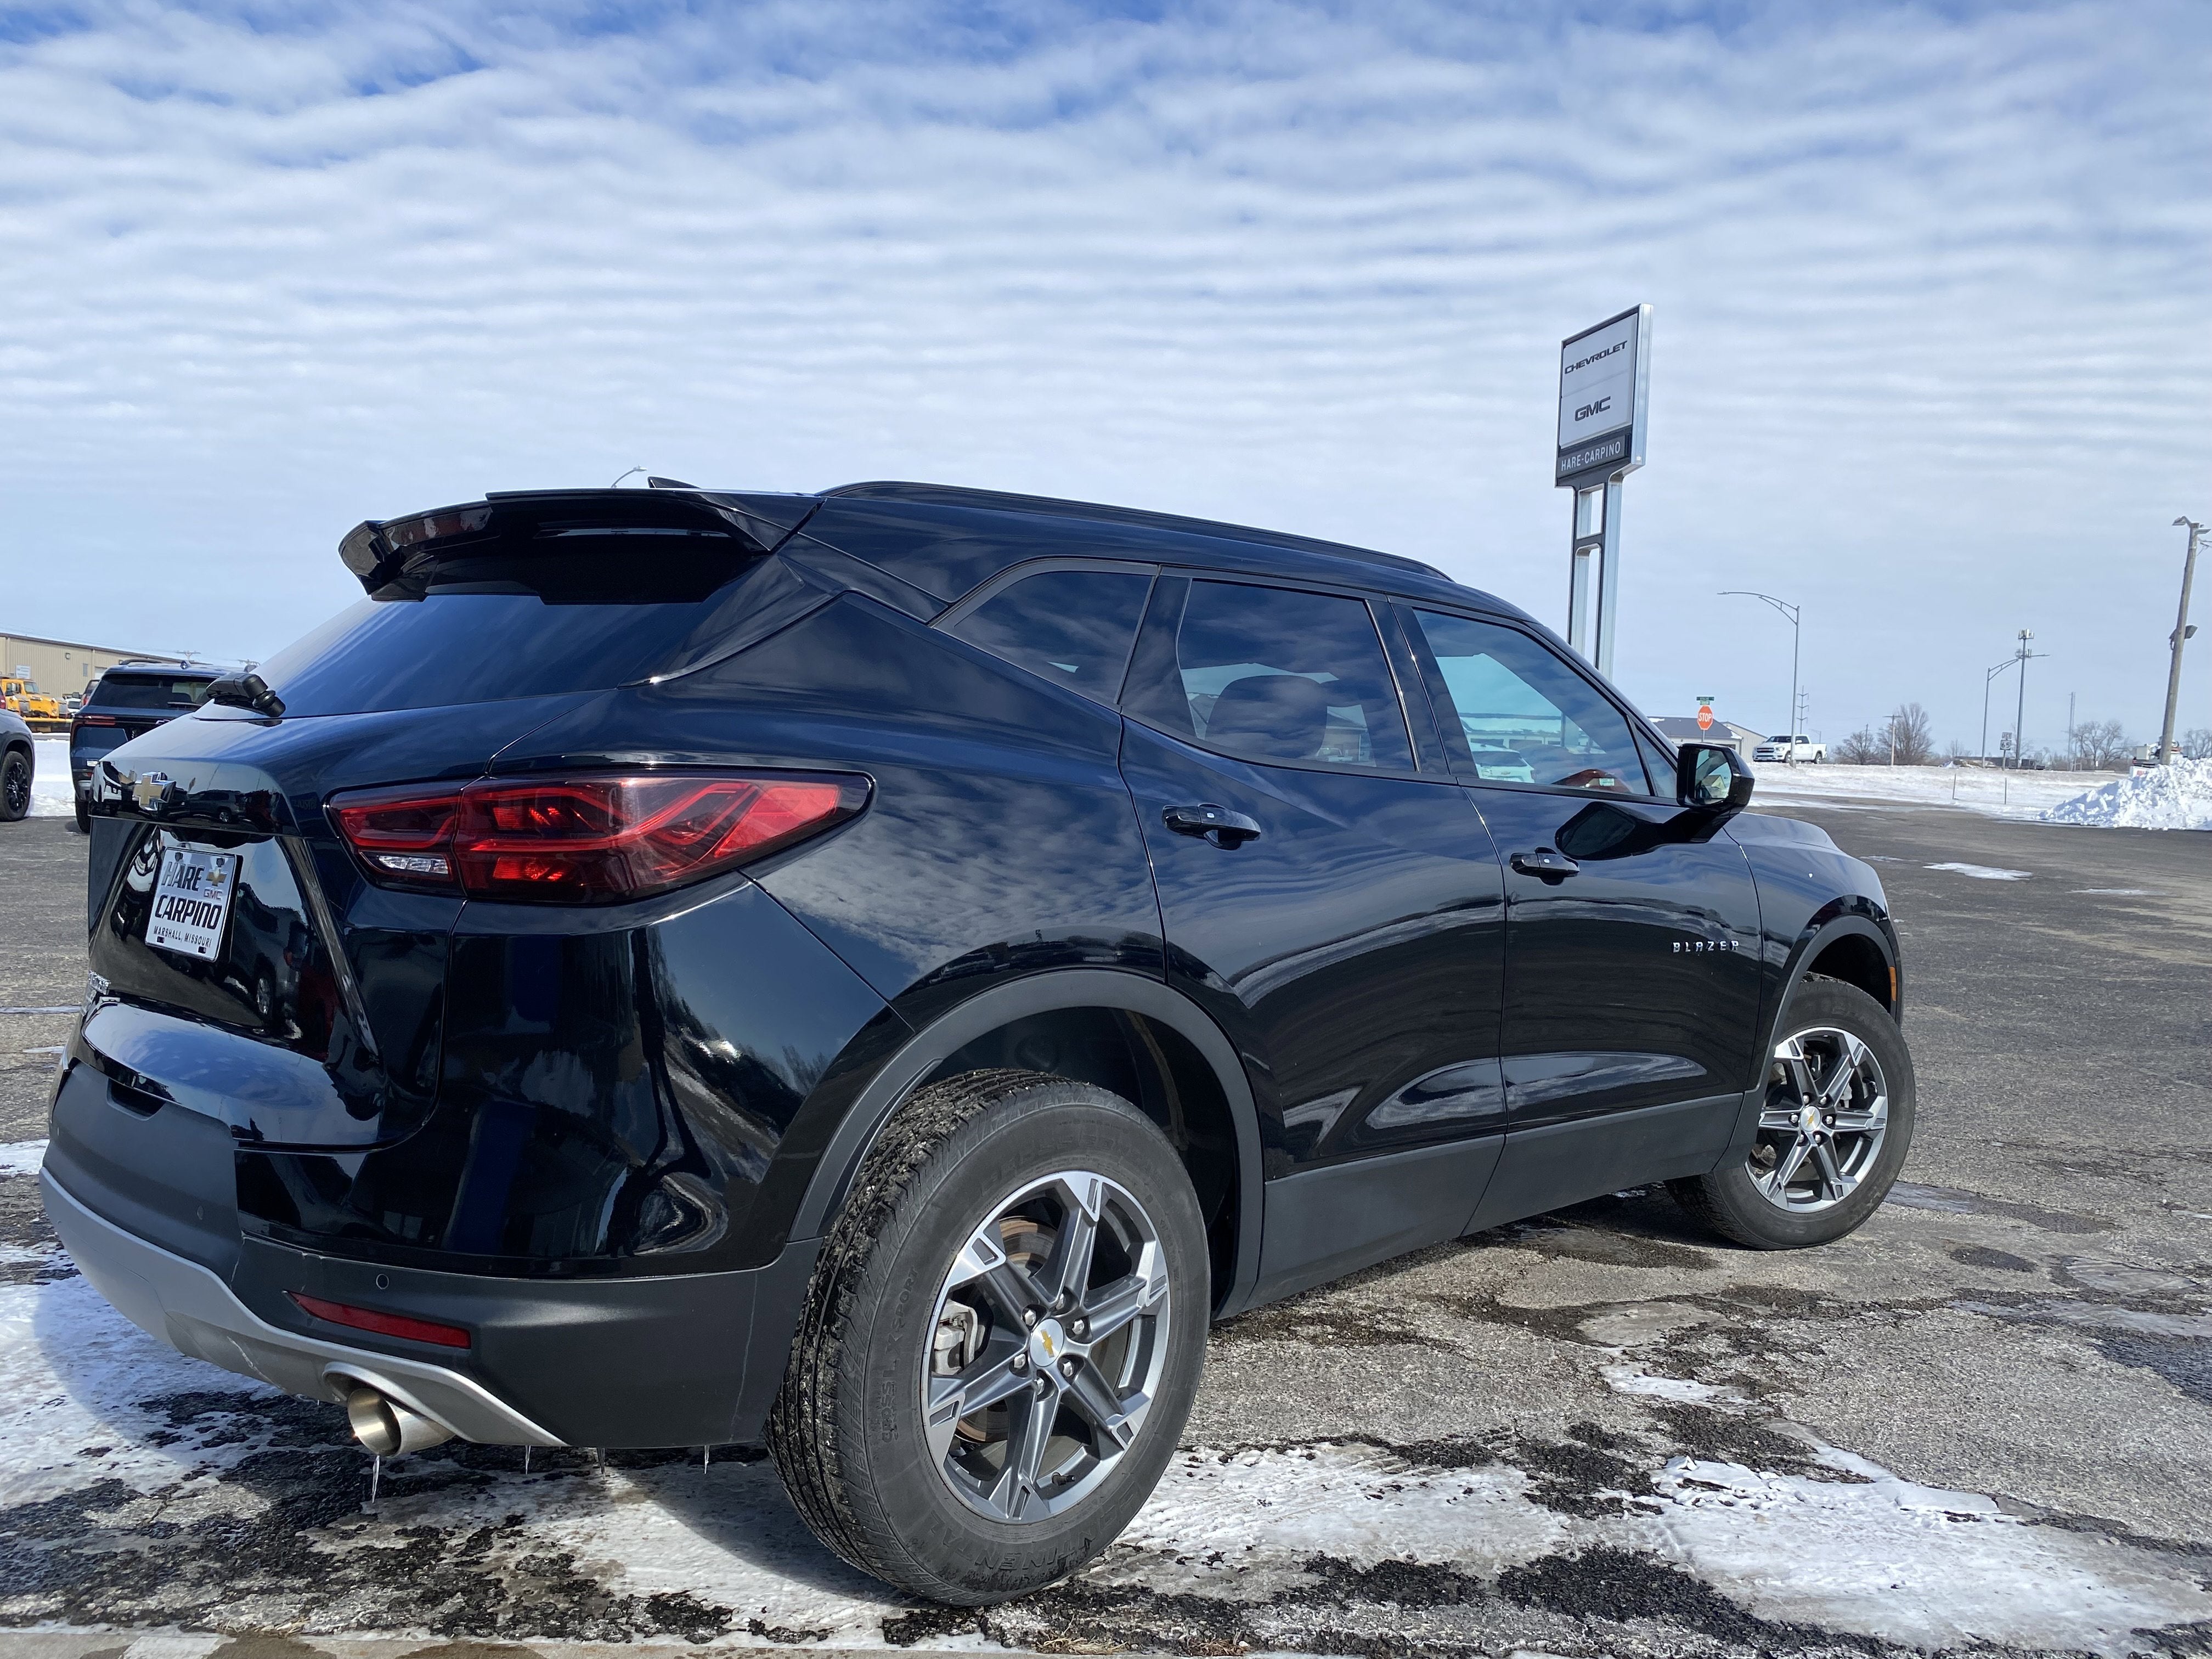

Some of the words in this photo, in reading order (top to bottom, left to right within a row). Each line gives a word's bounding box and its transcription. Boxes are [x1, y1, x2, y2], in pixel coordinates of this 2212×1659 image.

[1564, 340, 1628, 374] CHEVROLET
[1574, 396, 1611, 421] GMC
[1561, 441, 1621, 471] HARE-CARPINO
[1699, 713, 1712, 722] STOP
[161, 861, 205, 891] HARE
[204, 887, 223, 901] GMC
[155, 894, 222, 929] CARPINO
[154, 925, 183, 943] MARSHALL,
[184, 932, 213, 947] MISSOURI
[1672, 940, 1739, 952] BLAZER
[882, 1380, 894, 1443] CROSS
[891, 1266, 918, 1331] SPORT
